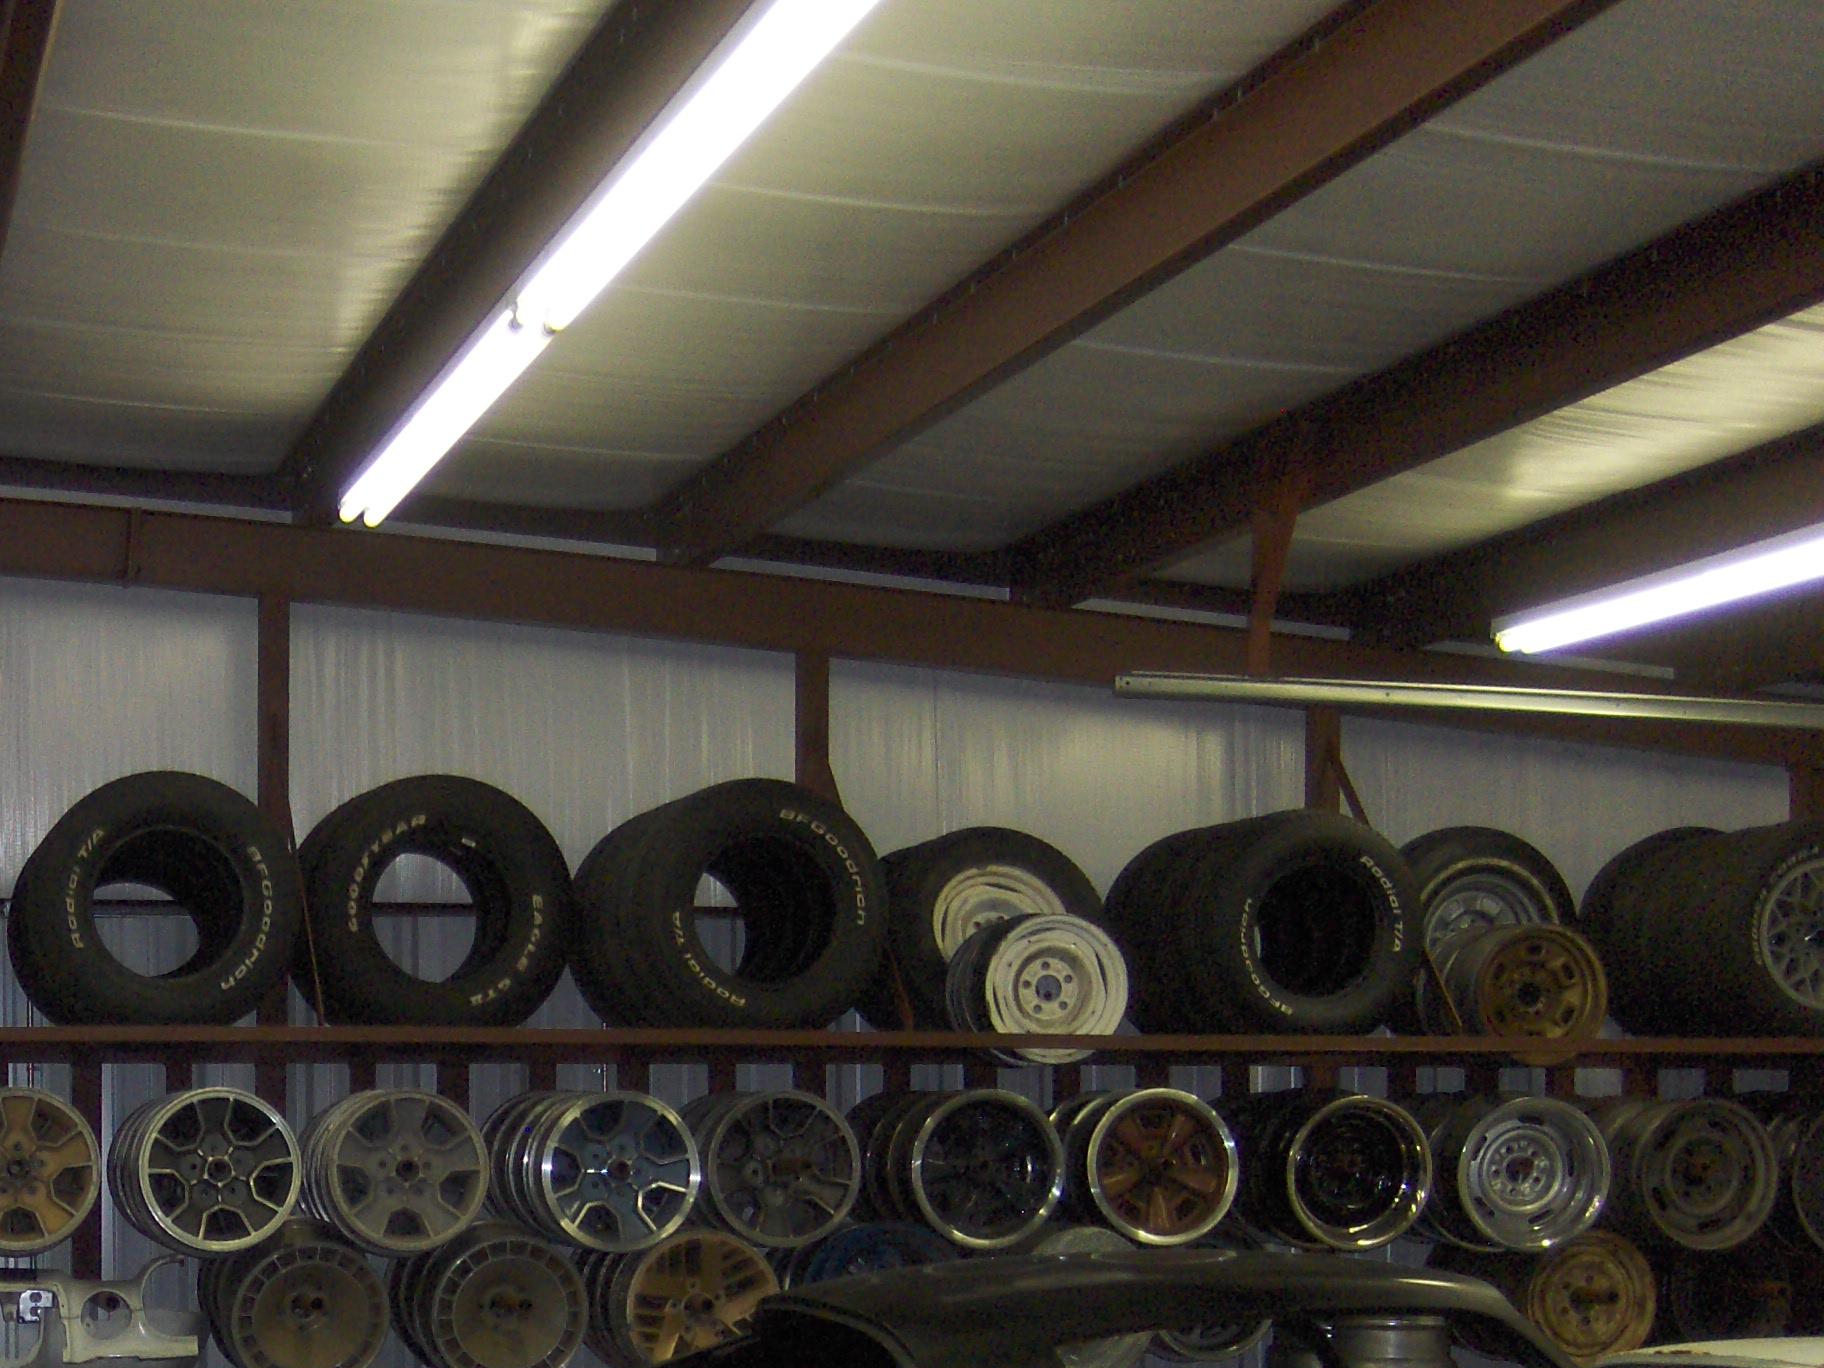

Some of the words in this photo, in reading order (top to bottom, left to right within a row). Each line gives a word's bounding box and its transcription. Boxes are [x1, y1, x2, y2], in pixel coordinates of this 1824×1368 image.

[220, 845, 273, 991] BFGoodrich
[346, 813, 428, 933] GOODYEAR
[779, 808, 867, 926] BFGoodrich
